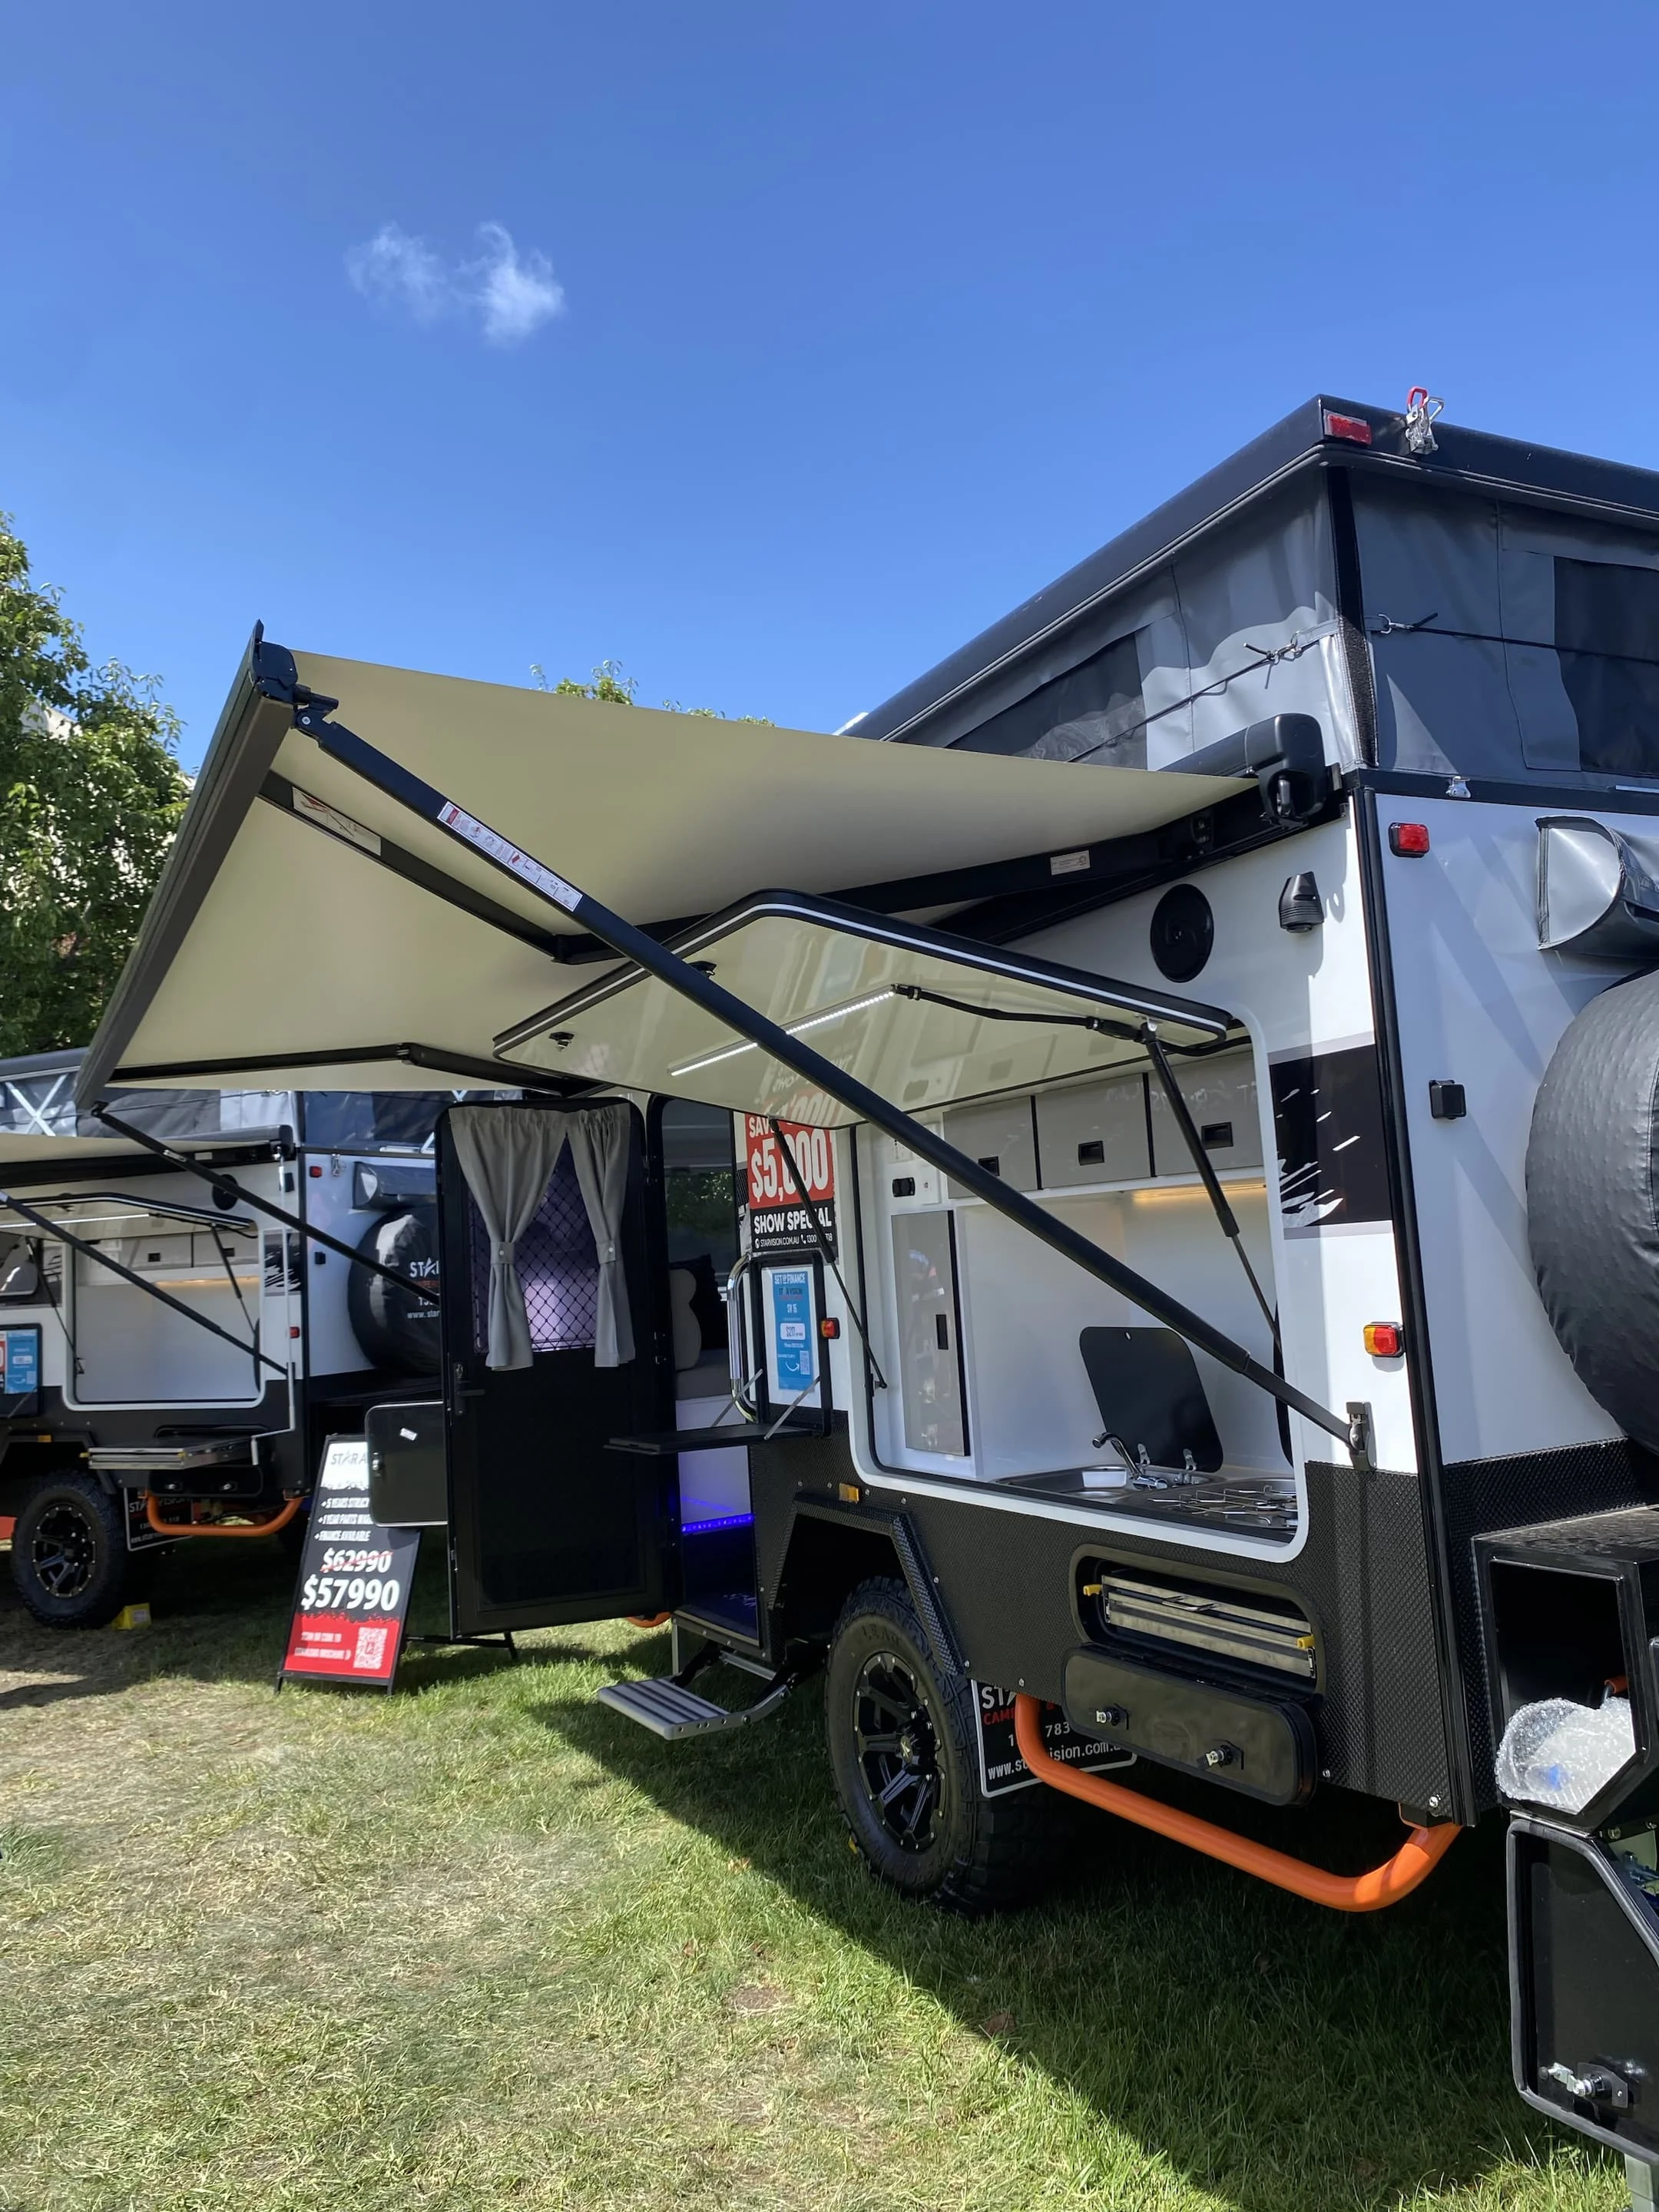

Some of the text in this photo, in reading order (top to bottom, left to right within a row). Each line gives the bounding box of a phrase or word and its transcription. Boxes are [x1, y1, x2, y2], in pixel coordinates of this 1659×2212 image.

[749, 1116, 777, 1138] SAV
[754, 1207, 832, 1234] SHOW SPECAL
[322, 1547, 392, 1574] $62990
[301, 1574, 400, 1611] $57990
[1045, 1721, 1071, 1738] 783
